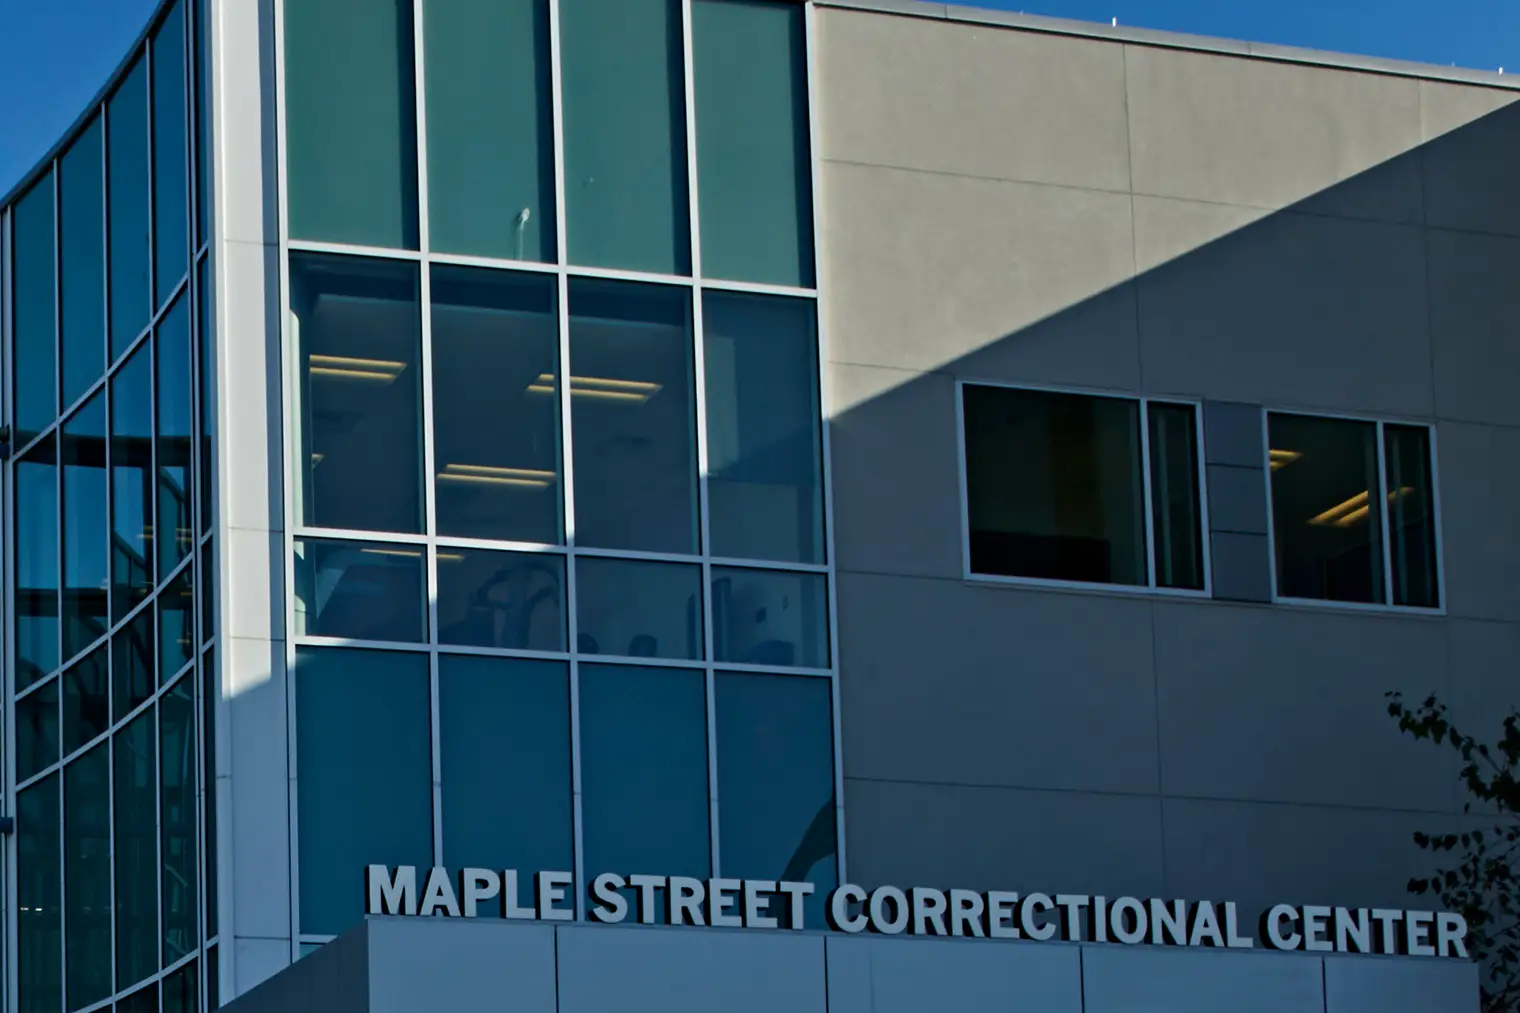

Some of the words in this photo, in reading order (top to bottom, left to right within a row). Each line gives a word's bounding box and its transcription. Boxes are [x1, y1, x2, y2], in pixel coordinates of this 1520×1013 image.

[367, 864, 573, 921] MAPLE
[594, 872, 815, 930] STREET
[831, 883, 1255, 949] CORRECTIONAL
[1267, 903, 1469, 958] CENTER
